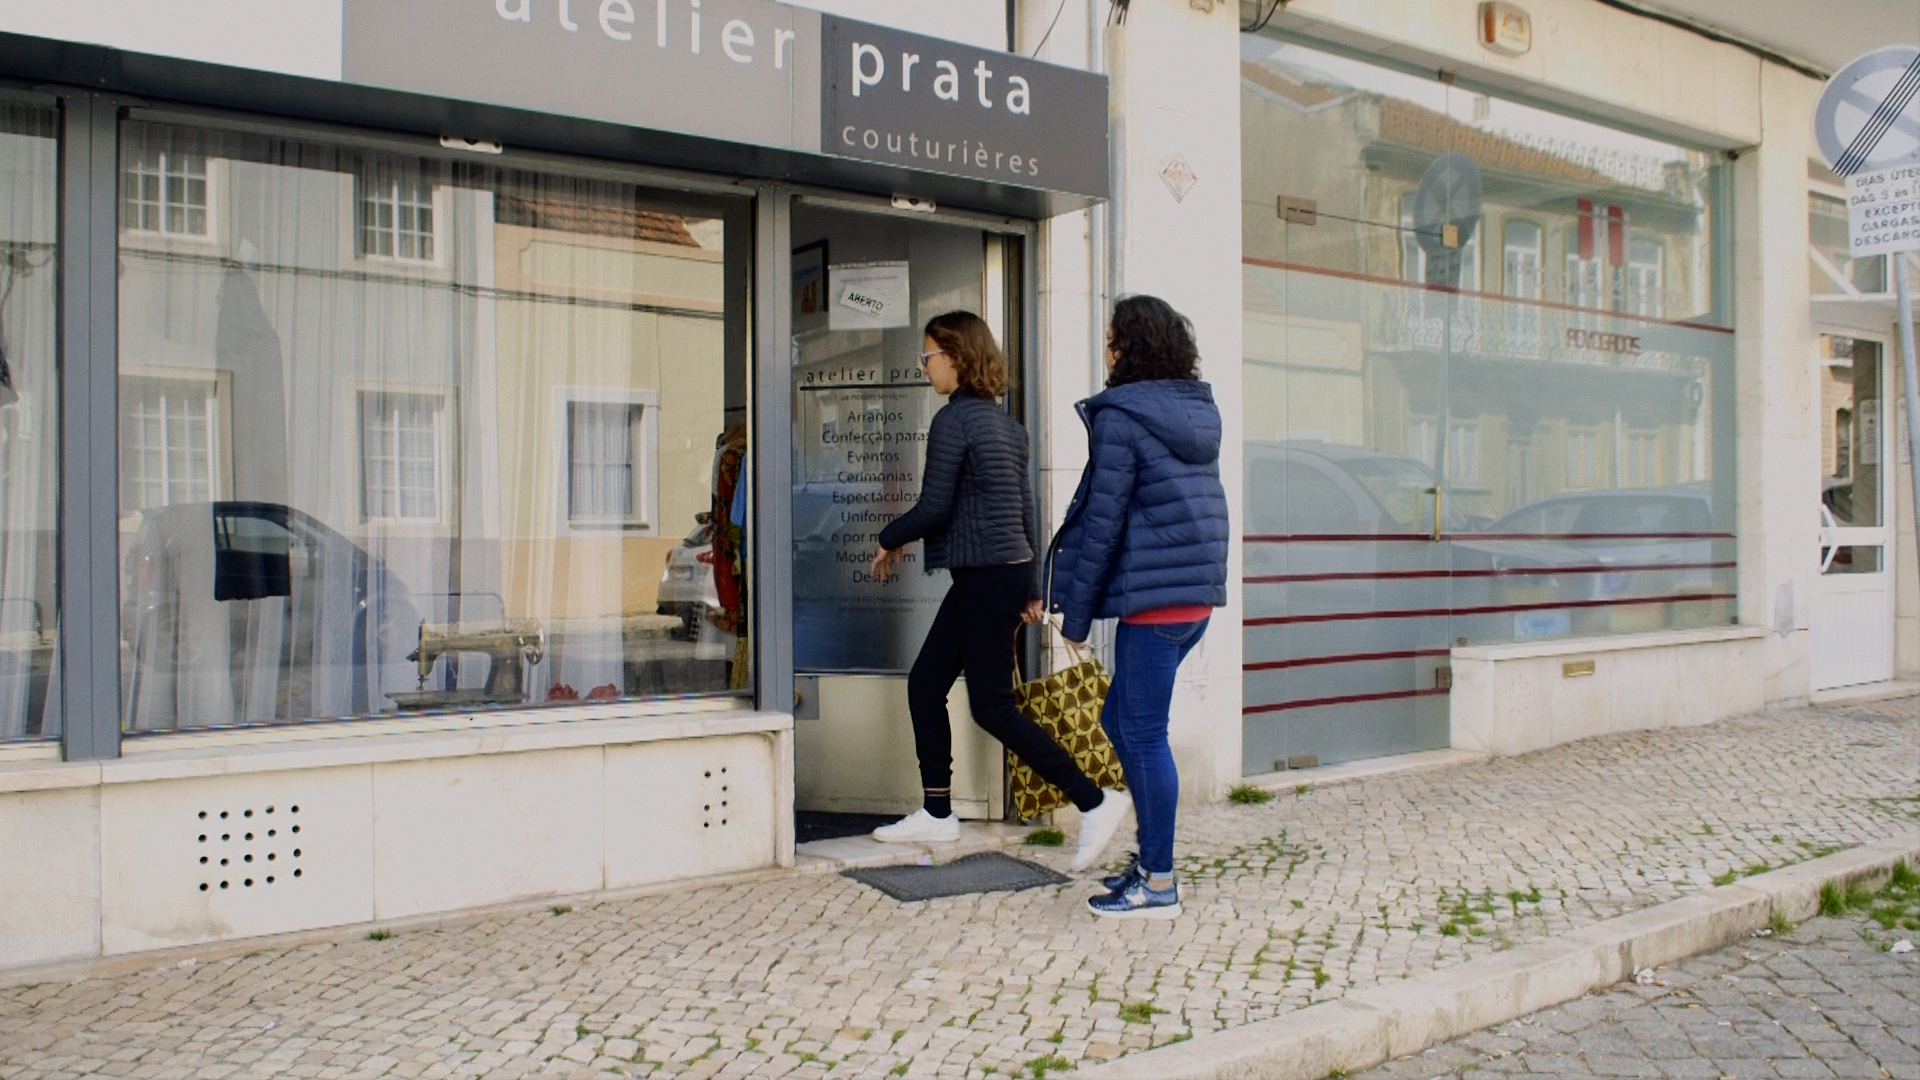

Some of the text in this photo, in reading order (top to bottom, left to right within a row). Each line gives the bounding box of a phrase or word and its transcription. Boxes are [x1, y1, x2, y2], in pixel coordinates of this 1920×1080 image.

[495, 0, 1031, 116] atelier prata
[842, 125, 1039, 176] couturières
[847, 292, 884, 311] ABERTO
[806, 367, 922, 383] atelier pra
[847, 410, 903, 425] Arranjos
[822, 430, 891, 445] Confecção
[847, 451, 899, 463] Eventos
[837, 470, 913, 482] Cerimónias
[832, 490, 919, 505] Espectáculos
[841, 509, 901, 522] Uniform
[842, 533, 865, 546] por
